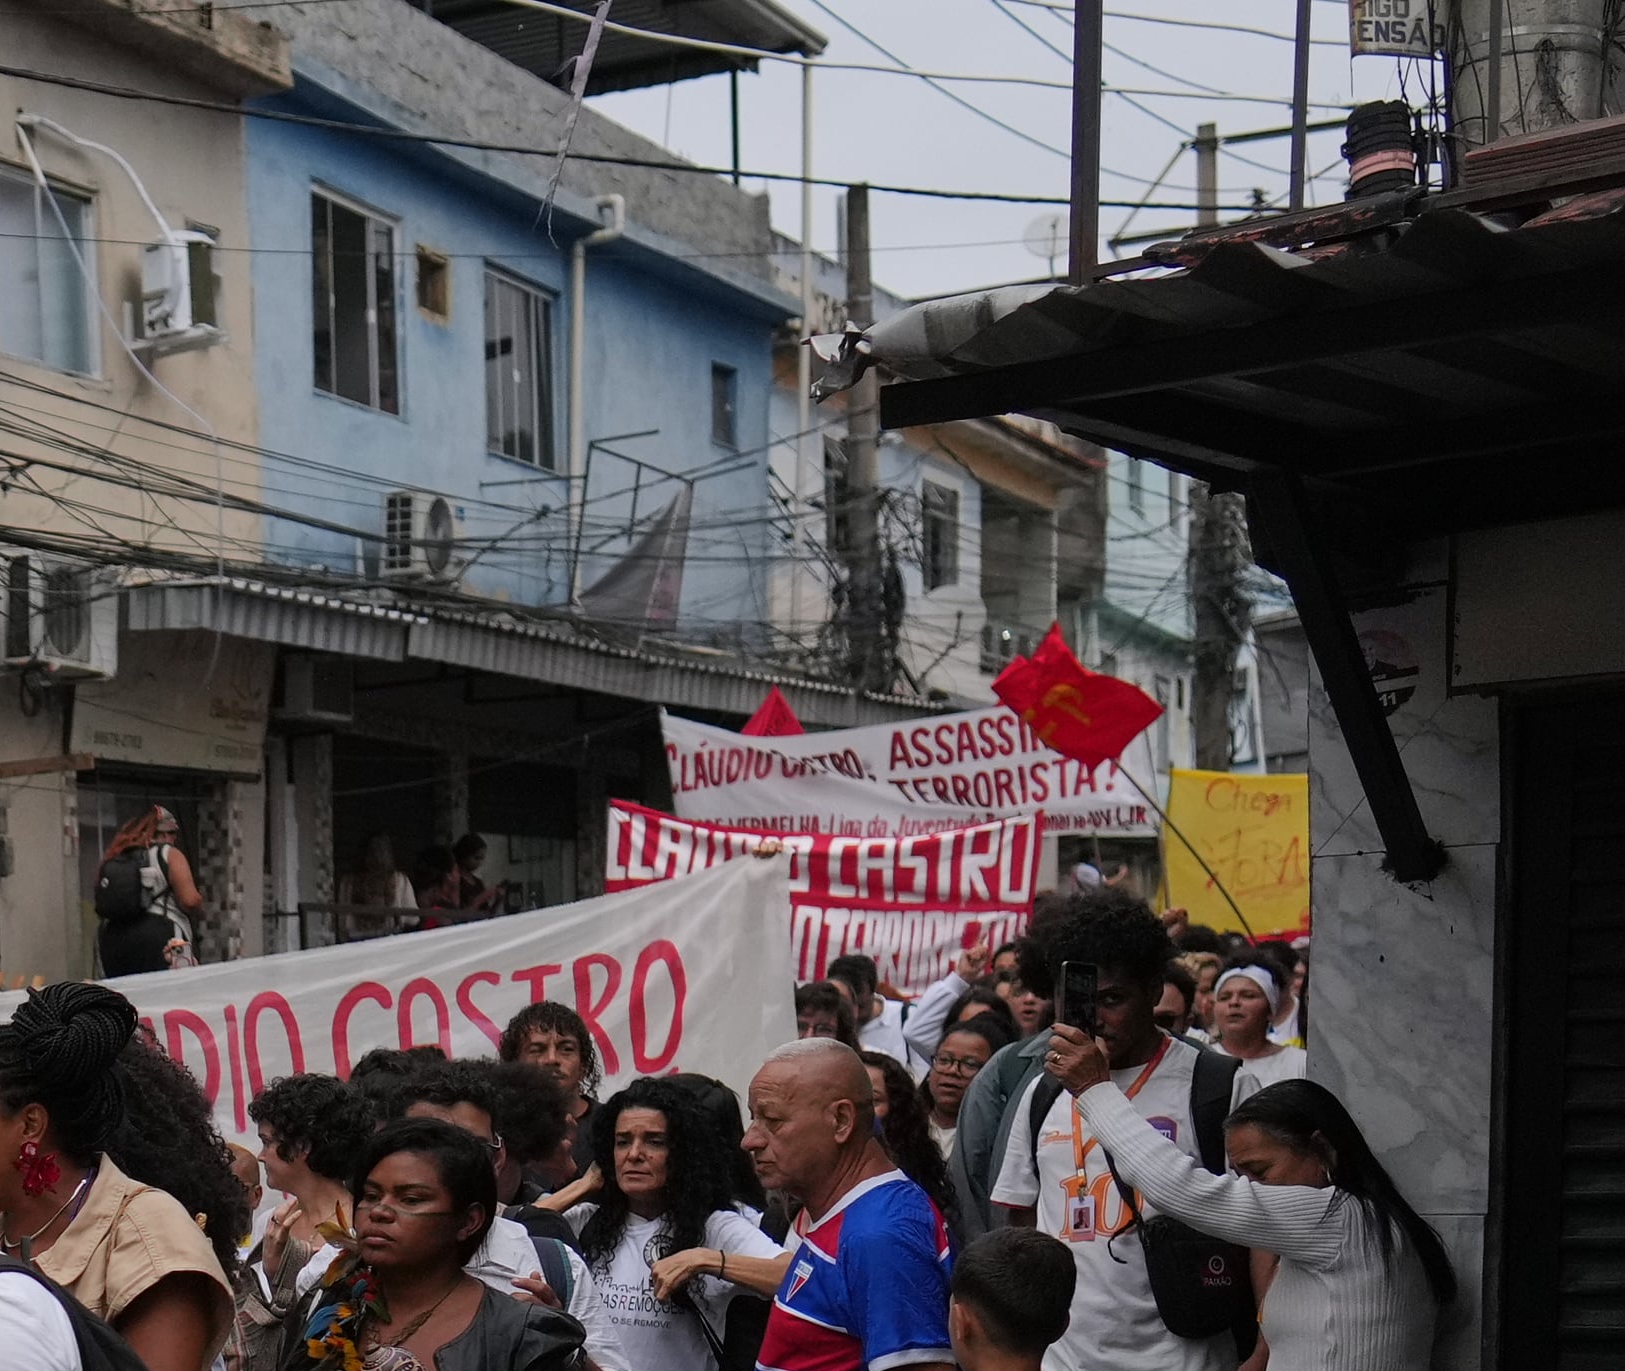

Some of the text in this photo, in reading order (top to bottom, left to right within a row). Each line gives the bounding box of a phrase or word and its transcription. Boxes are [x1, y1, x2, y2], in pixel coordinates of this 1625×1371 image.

[1356, 17, 1446, 47] ENSÃO
[664, 739, 773, 794] CLÁUDIO
[887, 757, 1119, 808] TERRORISTA!
[827, 813, 1036, 904] CASTRO
[331, 939, 688, 1082] CASTRO
[600, 1291, 618, 1309] AS
[620, 1317, 633, 1326] SE
[634, 1318, 671, 1329] REMOVE
